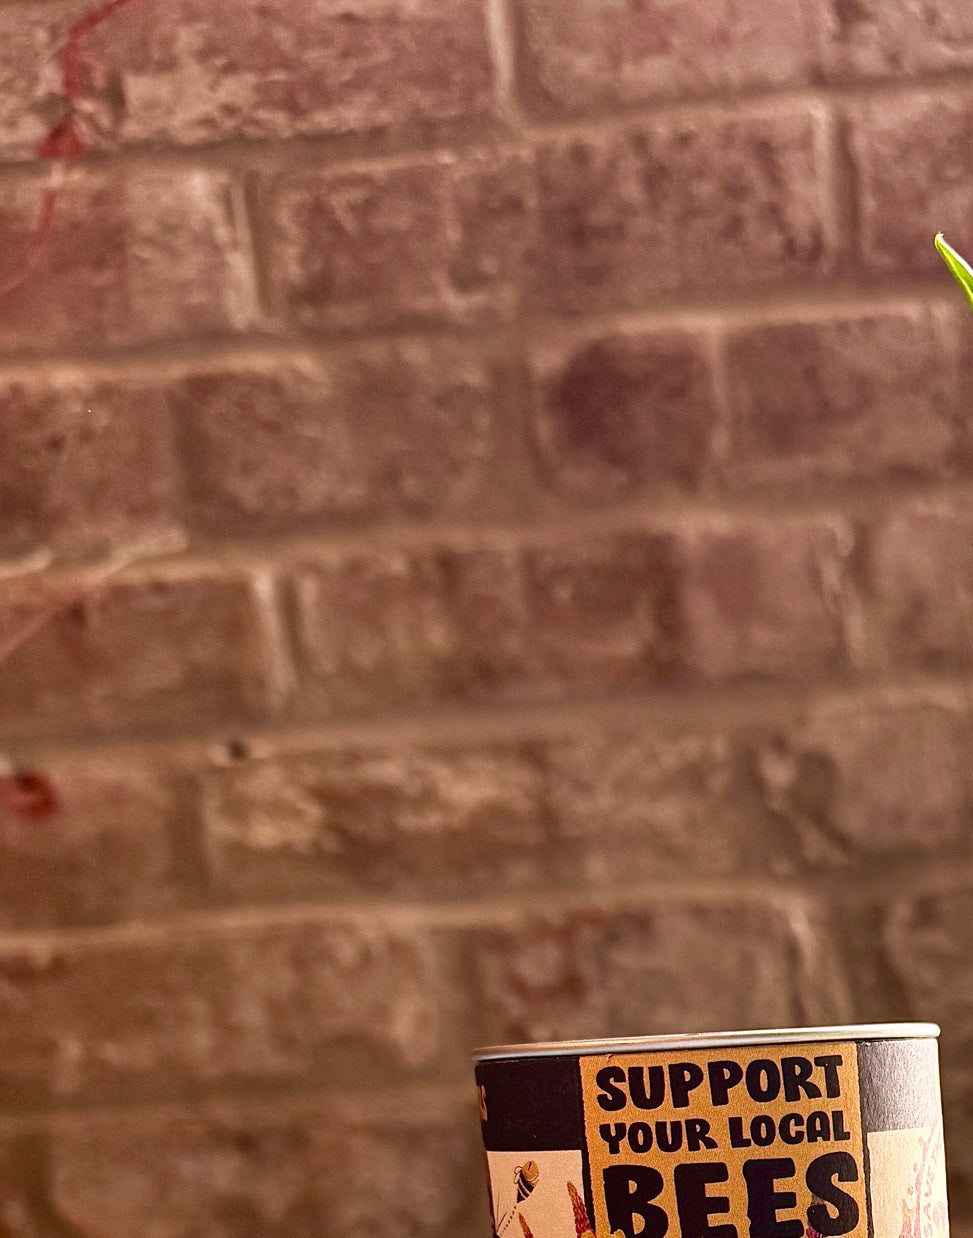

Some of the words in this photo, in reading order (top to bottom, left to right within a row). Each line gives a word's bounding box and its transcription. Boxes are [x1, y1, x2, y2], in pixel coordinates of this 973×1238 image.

[596, 1054, 843, 1111] SUPPORT
[599, 1115, 718, 1154] YOUR
[729, 1110, 851, 1148] LOCAL
